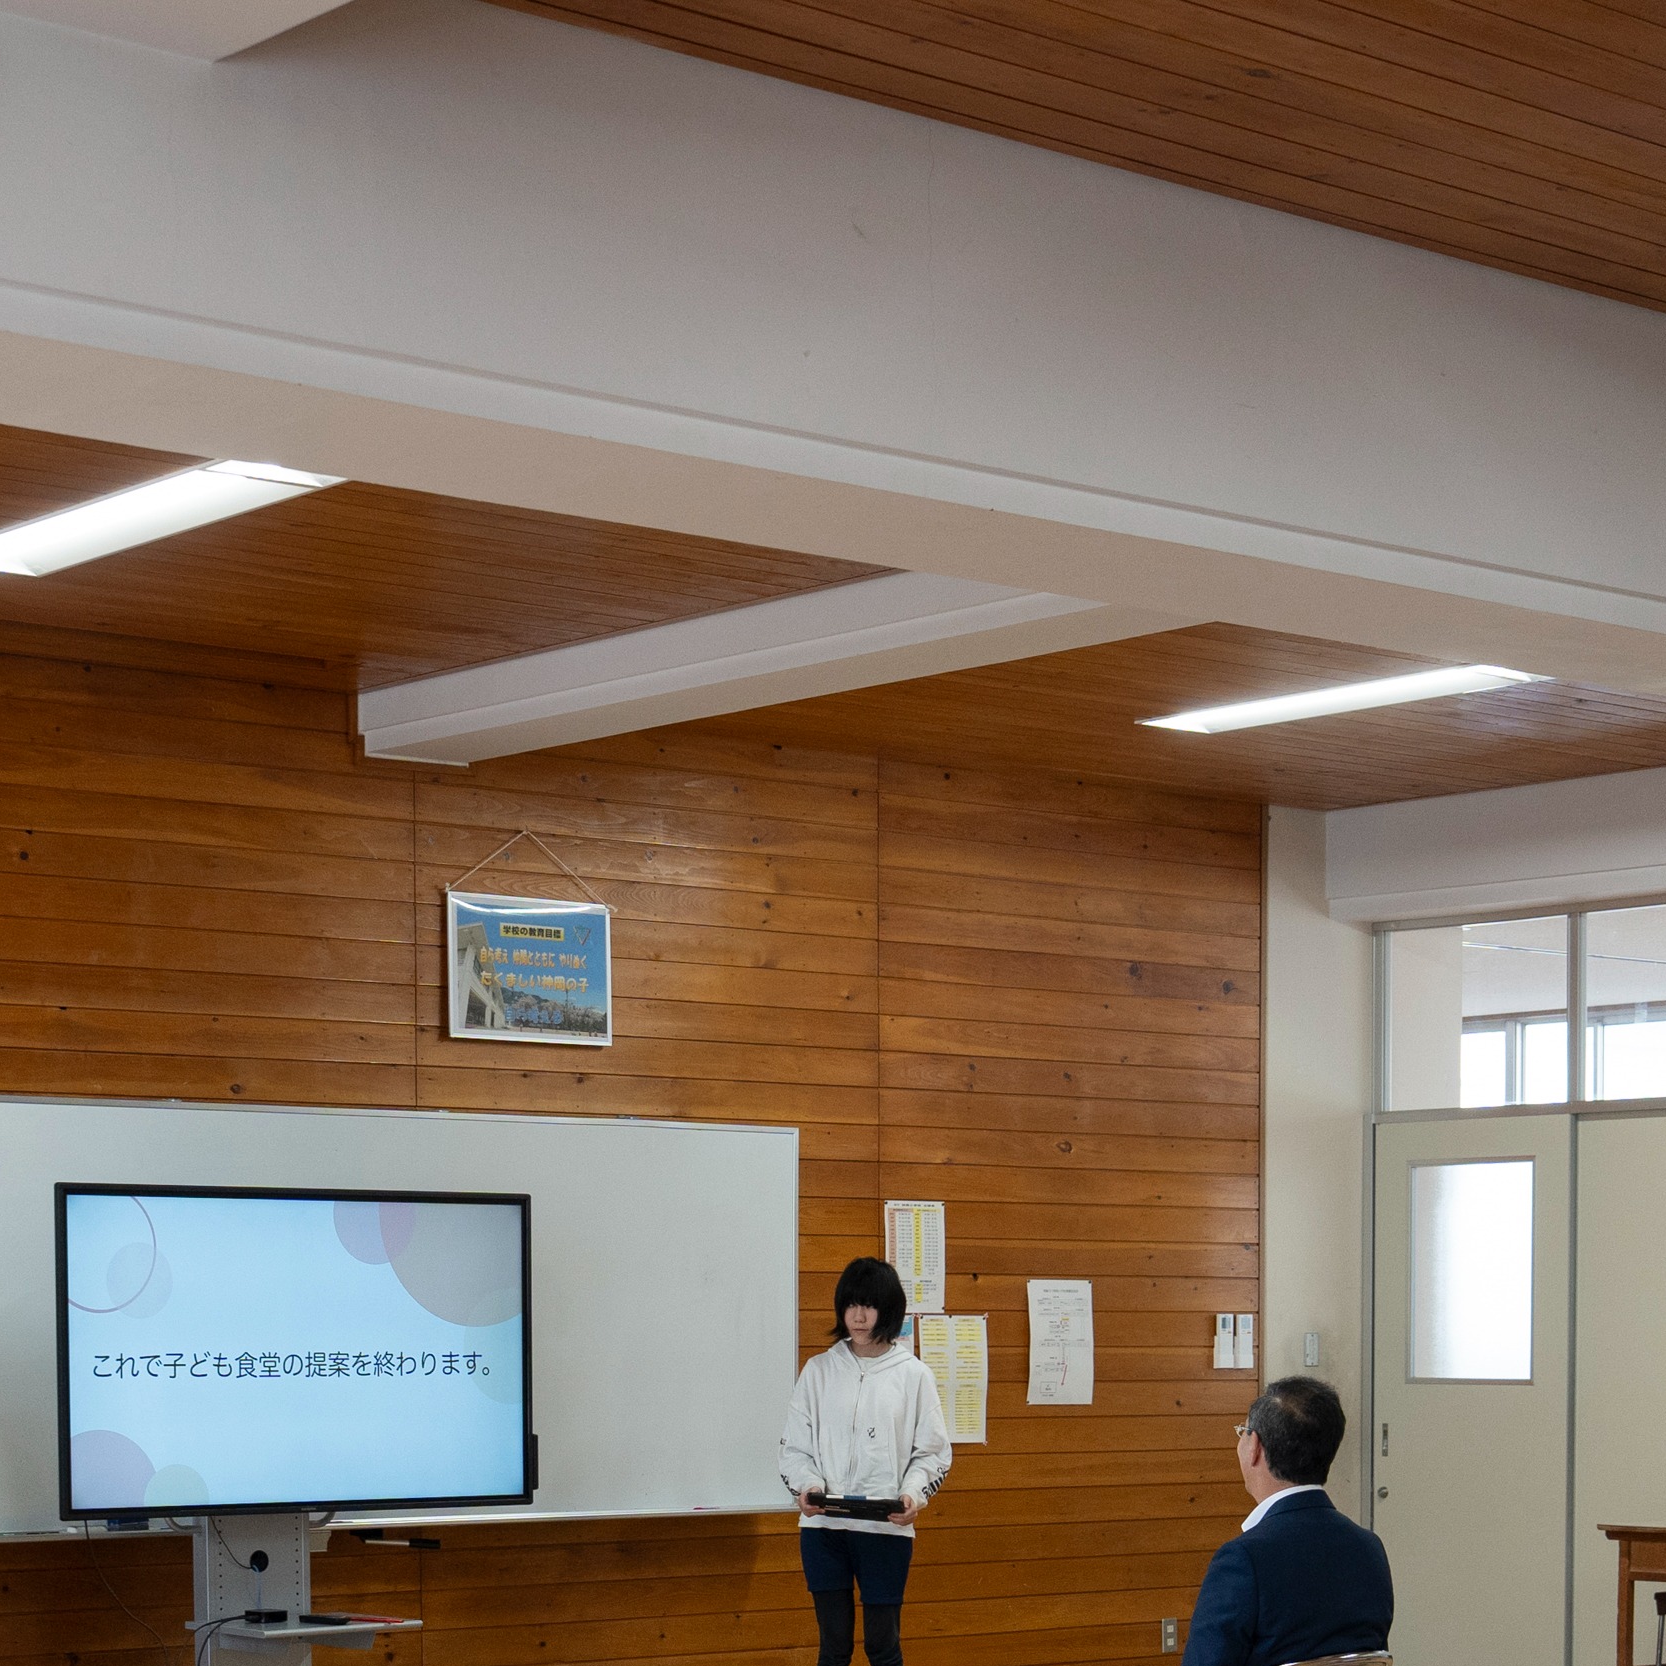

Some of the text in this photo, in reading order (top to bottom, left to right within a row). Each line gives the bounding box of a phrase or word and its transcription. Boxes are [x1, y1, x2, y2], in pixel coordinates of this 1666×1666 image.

[503, 924, 562, 939] 学校の教育目標
[480, 945, 587, 969] 自ら考え 仲間とともに やりぬく
[480, 971, 589, 993] たくましい神岡の子
[92, 1351, 490, 1378] これで子ども食堂の提案を終わります。
